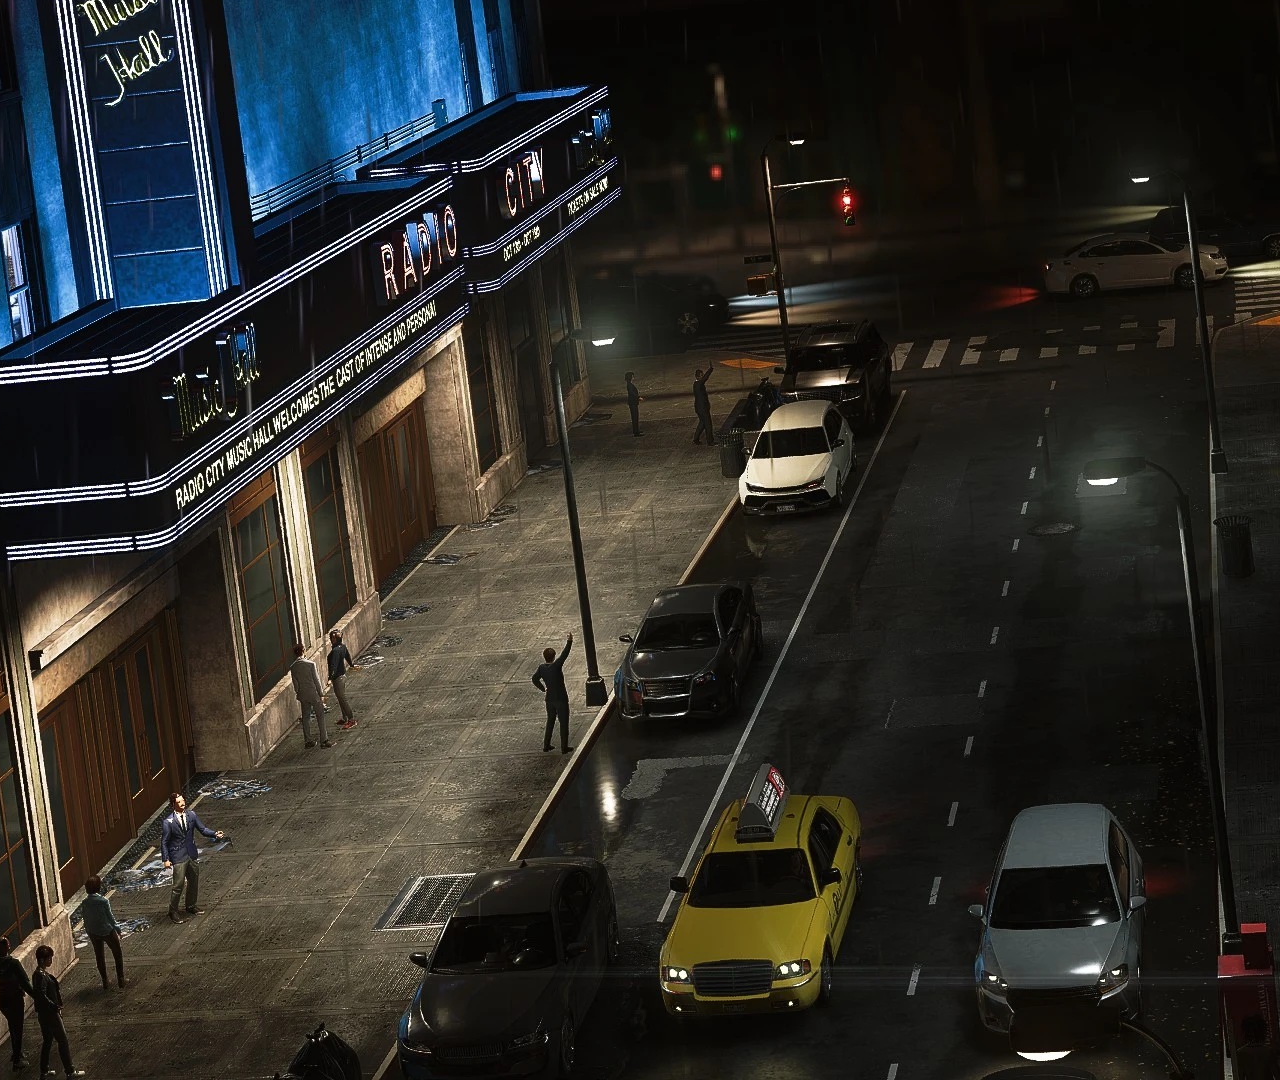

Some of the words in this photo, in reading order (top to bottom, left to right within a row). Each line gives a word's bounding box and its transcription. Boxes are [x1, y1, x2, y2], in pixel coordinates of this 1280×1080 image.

[100, 30, 173, 107] Hall
[505, 147, 545, 217] CITY
[380, 204, 457, 300] RADIO
[175, 473, 205, 510] RADIO
[206, 456, 226, 488] CITY
[226, 436, 253, 470] MUSIC
[252, 422, 274, 451] HALL
[272, 386, 320, 436] WELCOMES
[319, 375, 336, 401] THE
[336, 358, 354, 388] CAST
[354, 350, 366, 374] OF
[364, 332, 394, 366] INTENSE
[393, 322, 406, 346] AND
